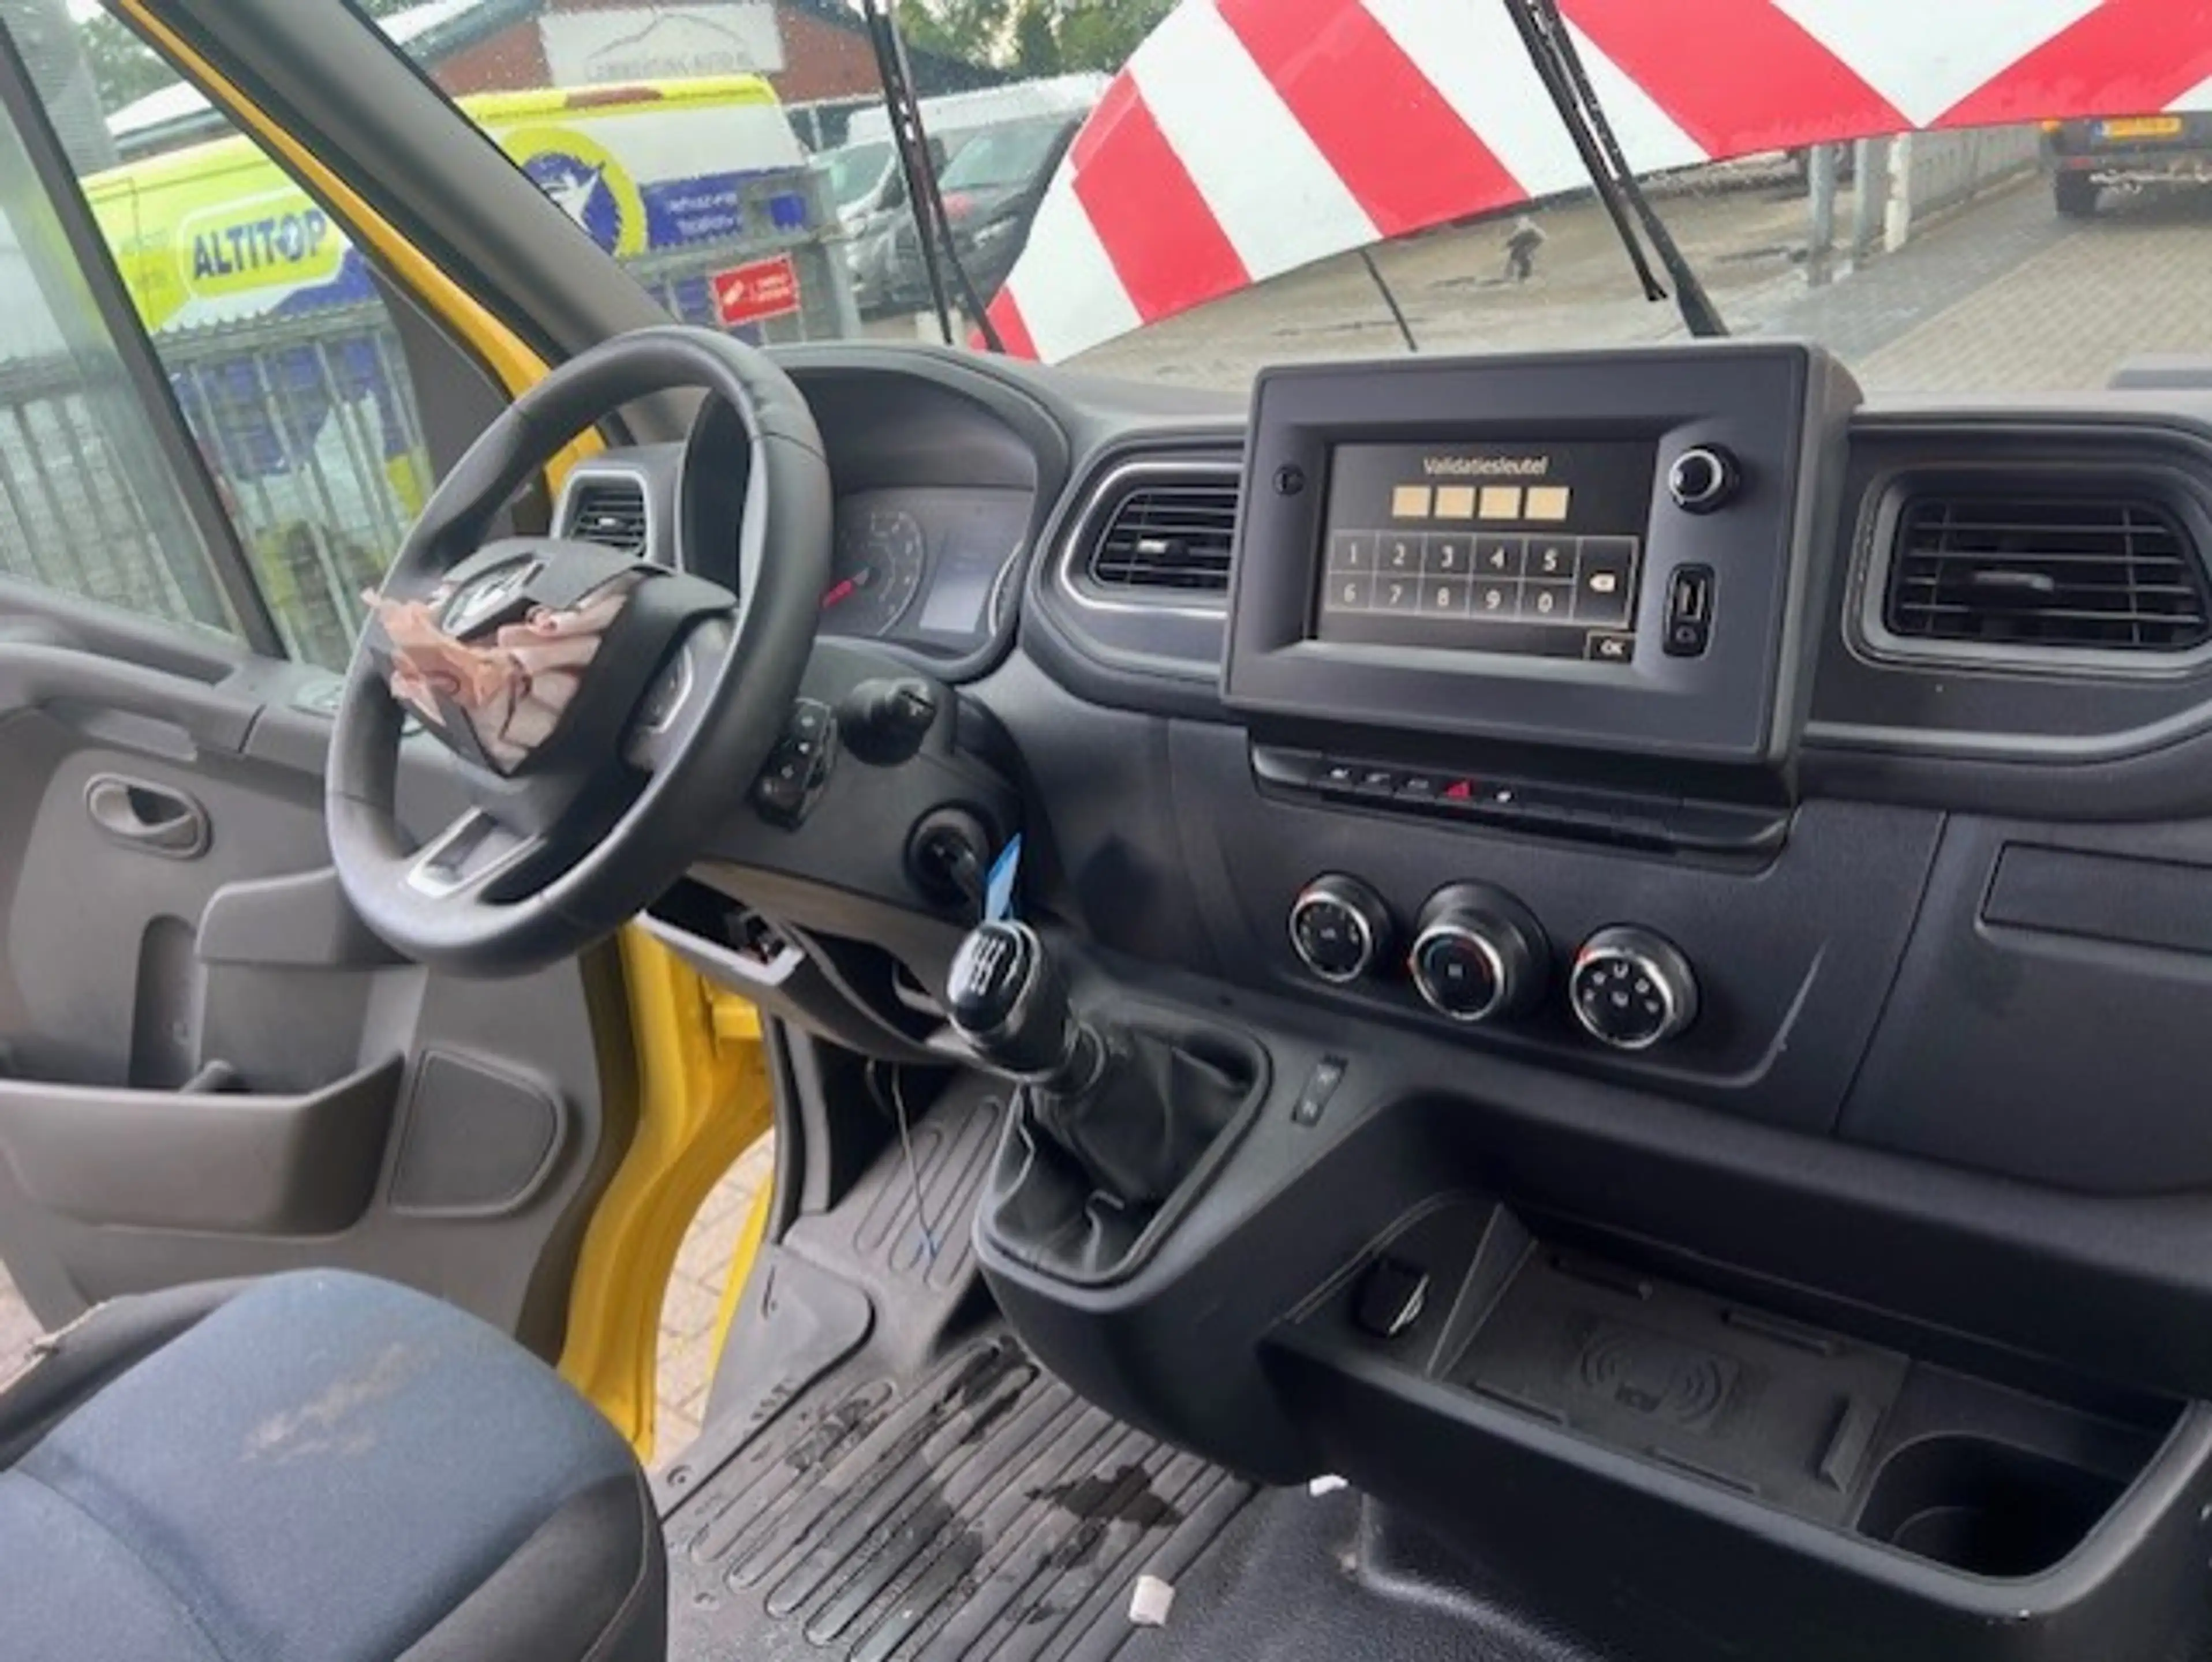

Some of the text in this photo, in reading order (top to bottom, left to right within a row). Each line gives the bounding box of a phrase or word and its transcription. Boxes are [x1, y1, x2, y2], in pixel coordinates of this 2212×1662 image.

[193, 208, 327, 280] ALTITOP
[1350, 542, 1557, 571] 1 2 3 4 5
[1343, 582, 1553, 613] 6 7 8 9 0
